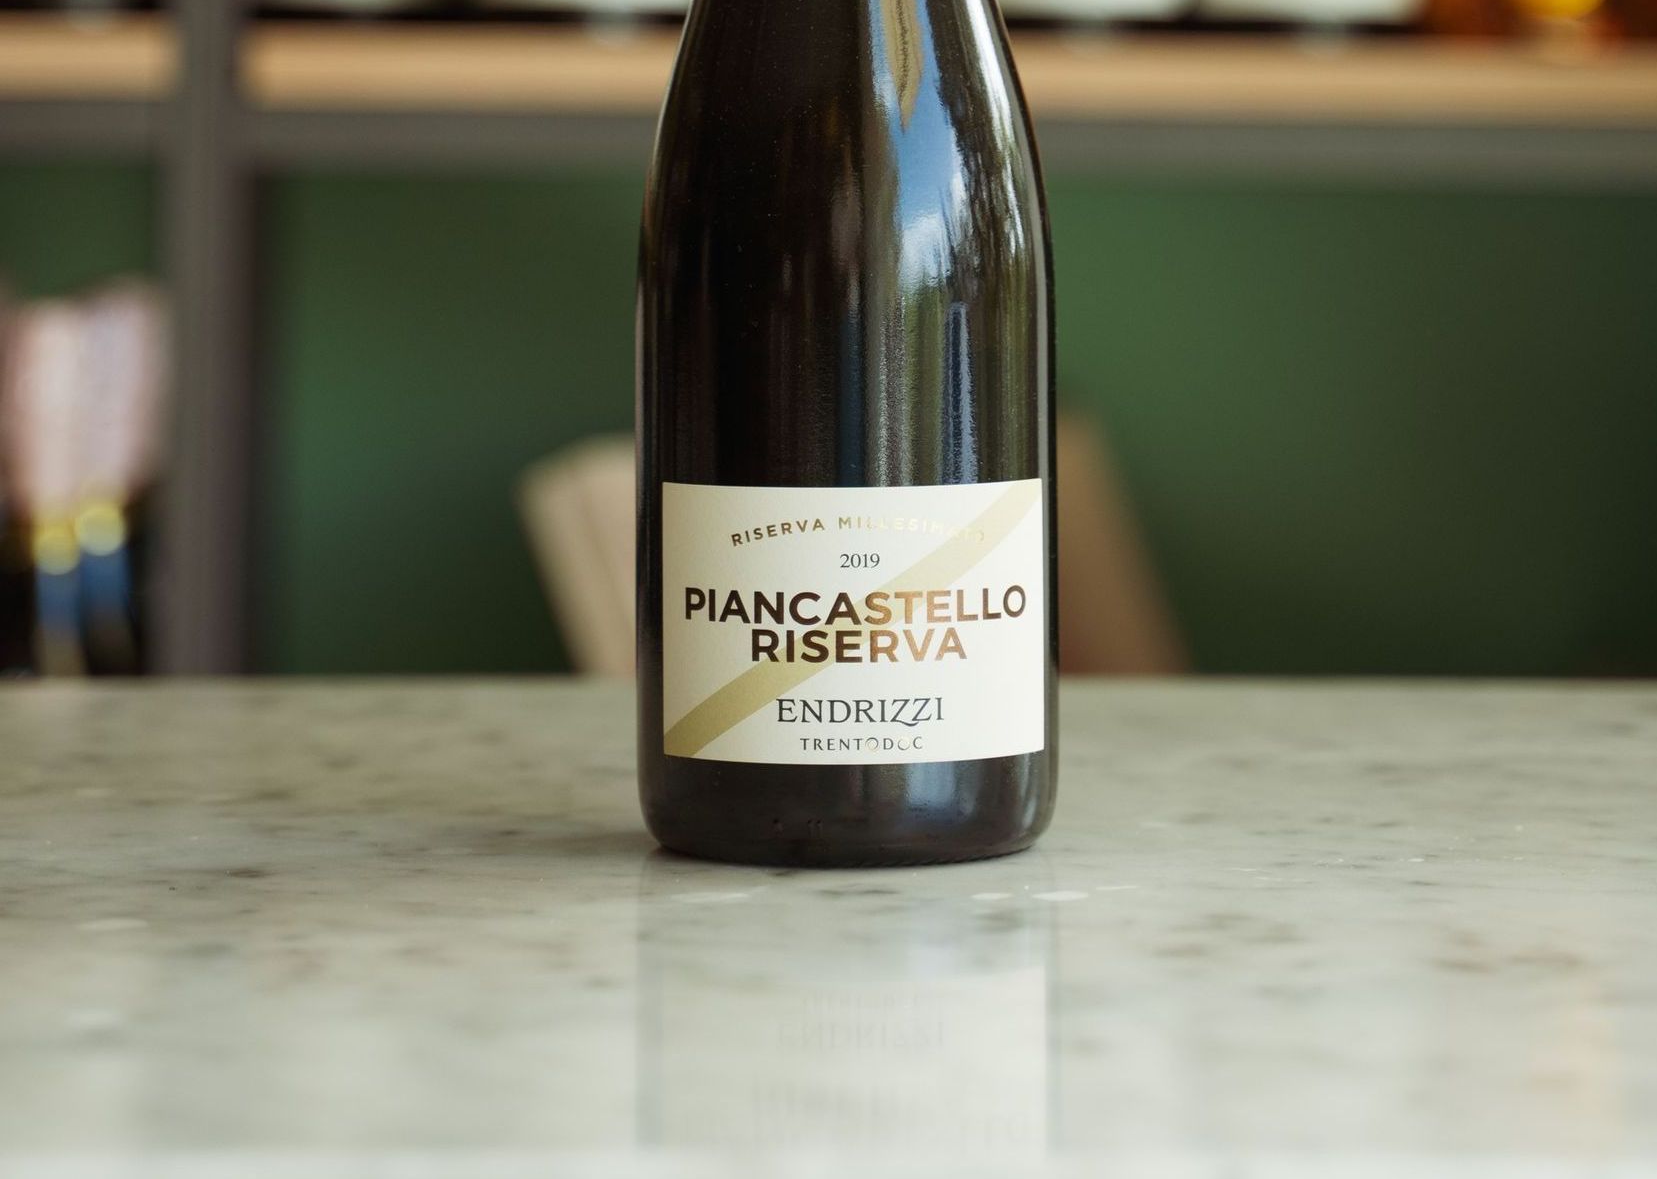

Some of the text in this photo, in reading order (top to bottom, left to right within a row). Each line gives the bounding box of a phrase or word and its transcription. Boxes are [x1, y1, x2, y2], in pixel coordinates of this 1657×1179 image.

[731, 518, 825, 547] RISERVA
[840, 553, 881, 569] 2019
[685, 585, 1026, 625] PIANCASTELLO
[751, 627, 966, 663] RISERVA
[776, 697, 944, 727] ENDRIZZI
[800, 736, 923, 751] TRENTODOC
